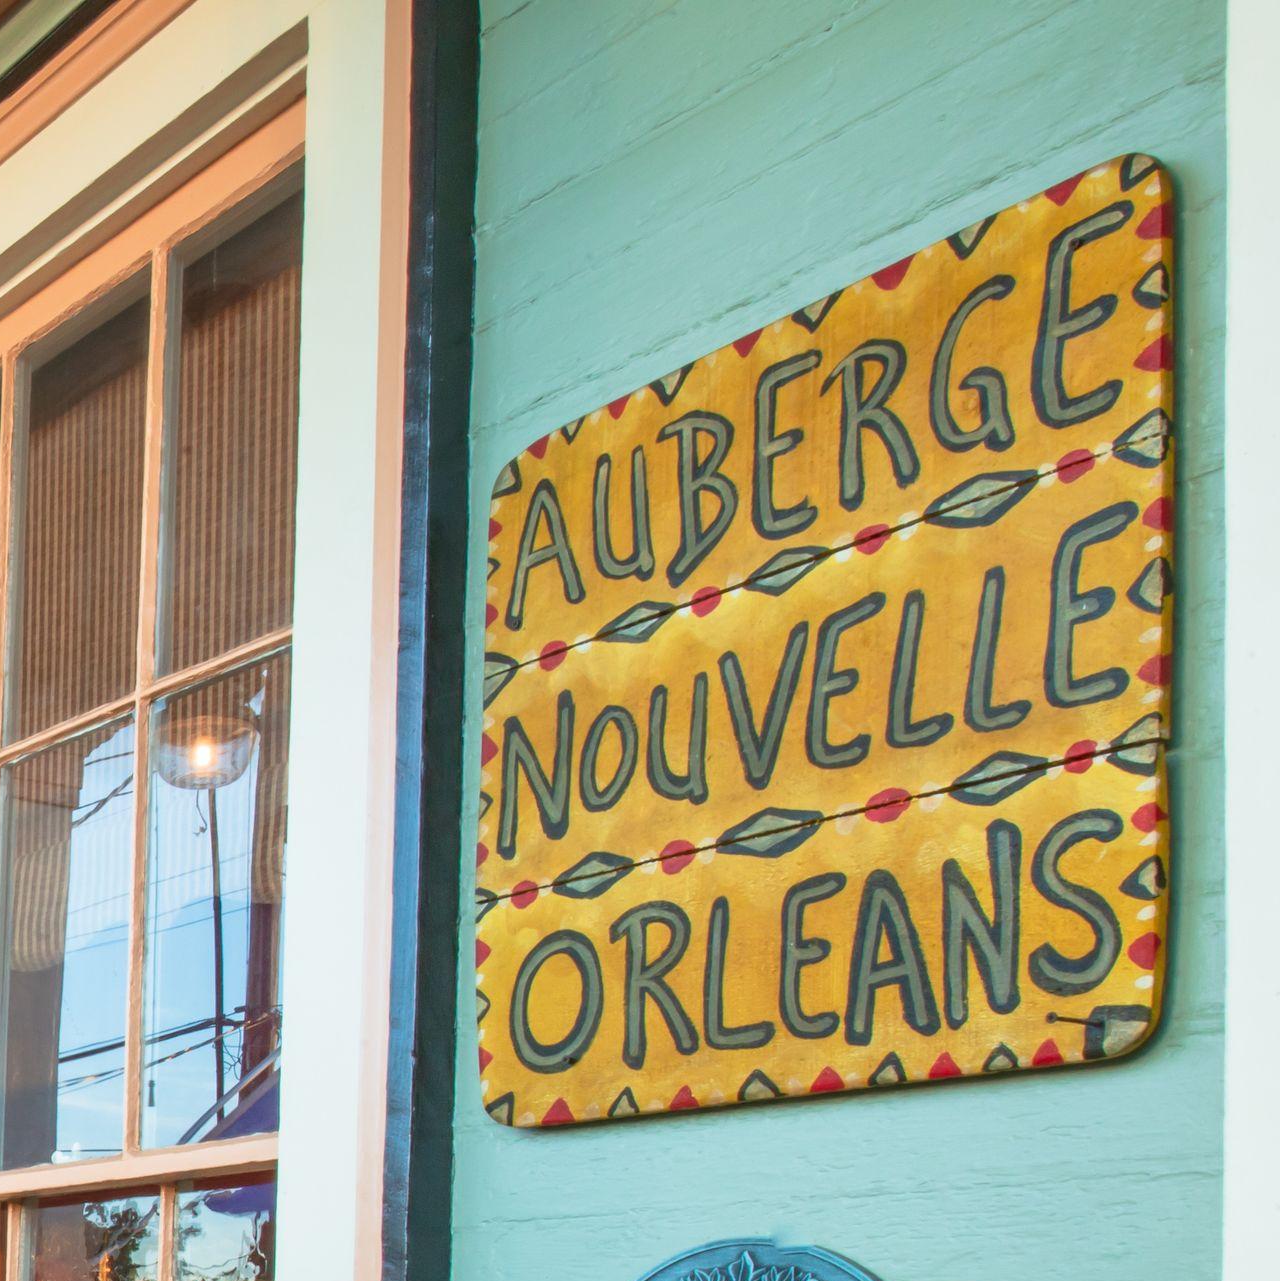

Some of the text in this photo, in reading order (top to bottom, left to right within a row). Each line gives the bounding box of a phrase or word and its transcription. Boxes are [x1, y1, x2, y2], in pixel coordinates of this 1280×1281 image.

[505, 200, 1135, 631] AUBERGE
[495, 501, 1139, 858] NOUVELLE
[509, 809, 1124, 1073] ORLEANS
